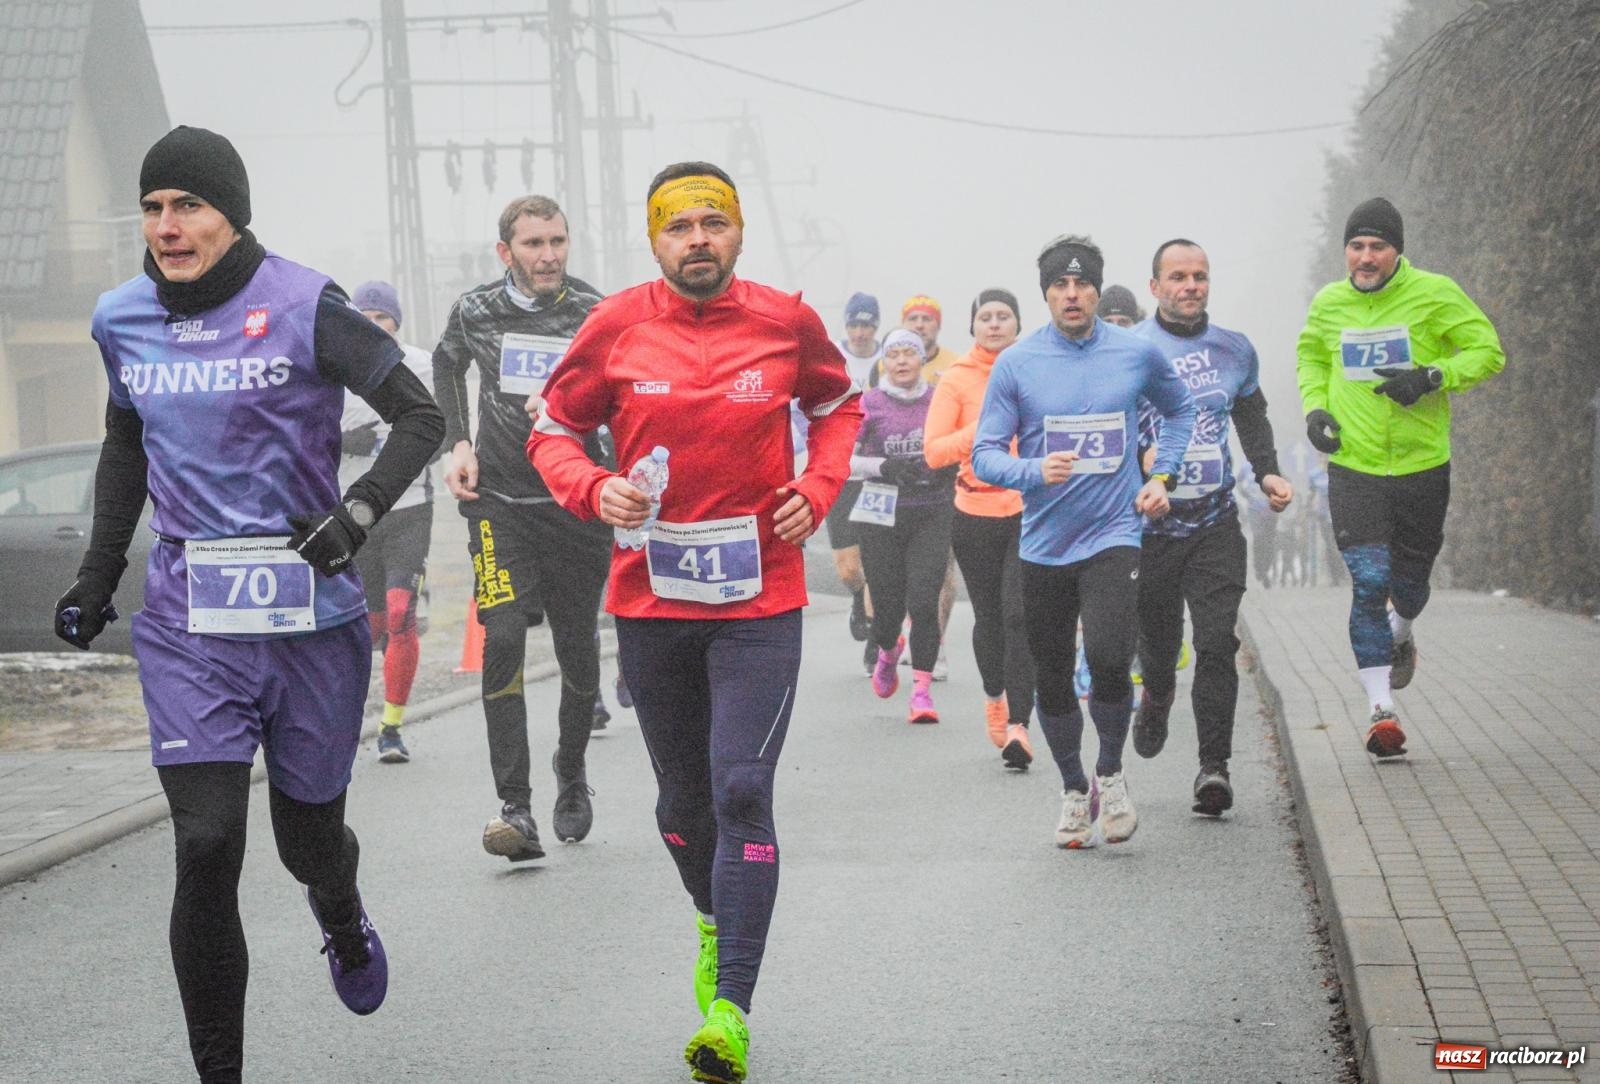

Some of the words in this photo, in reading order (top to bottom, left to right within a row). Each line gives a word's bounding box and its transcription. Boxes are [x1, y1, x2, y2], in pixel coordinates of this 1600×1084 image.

[1172, 349, 1211, 376] RSY
[1356, 342, 1389, 367] 75
[120, 356, 293, 396] RUNNERS
[1068, 432, 1105, 457] 73
[677, 546, 727, 581] 41
[220, 566, 277, 606] 70
